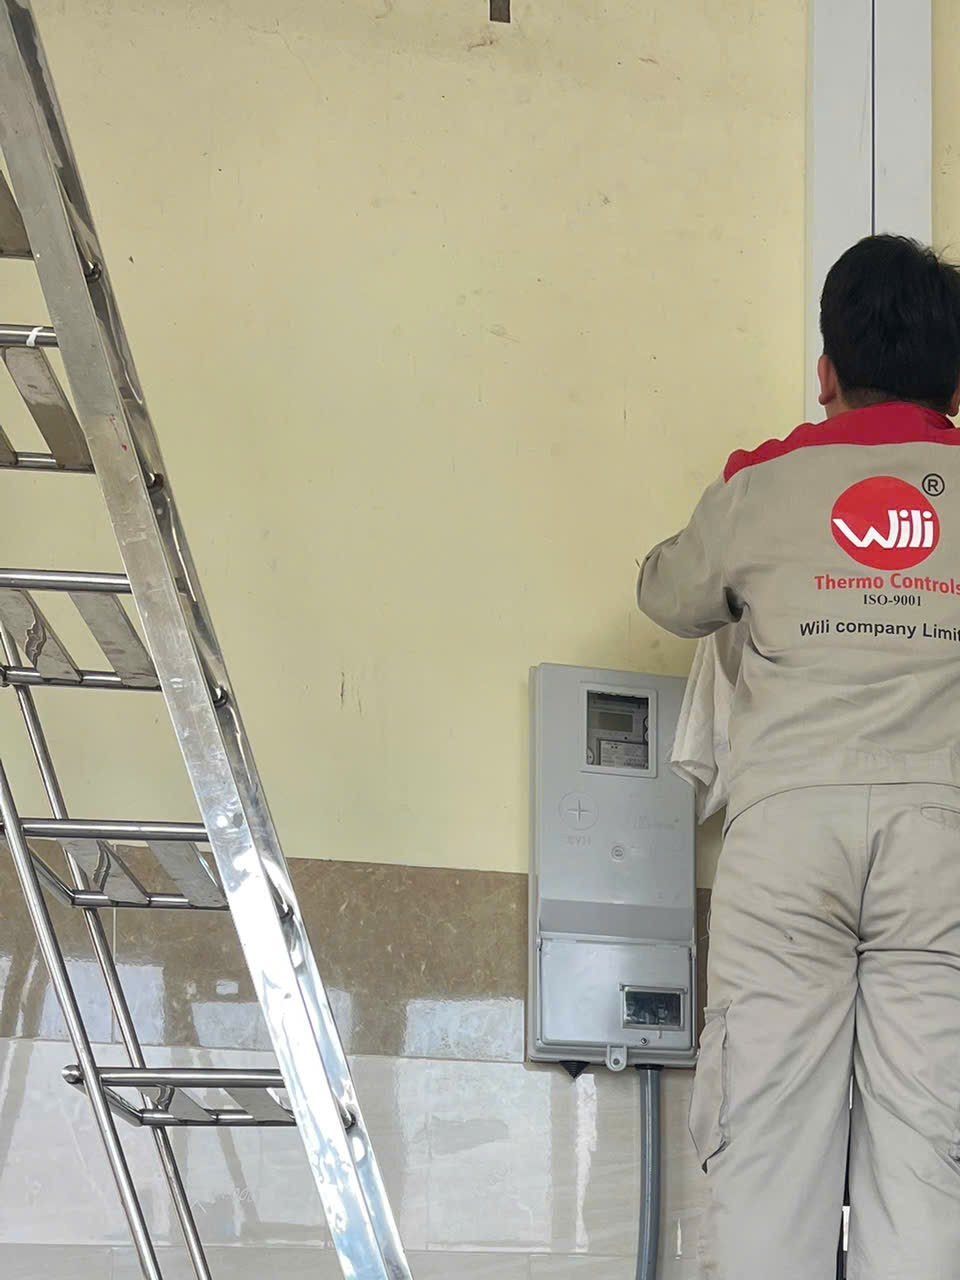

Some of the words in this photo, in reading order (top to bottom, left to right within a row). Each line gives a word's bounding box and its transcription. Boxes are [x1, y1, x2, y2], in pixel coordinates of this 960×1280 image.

[814, 574, 884, 591] Thermo
[863, 594, 922, 607] ISO-9001
[800, 620, 830, 637] Wili
[836, 621, 917, 639] company
